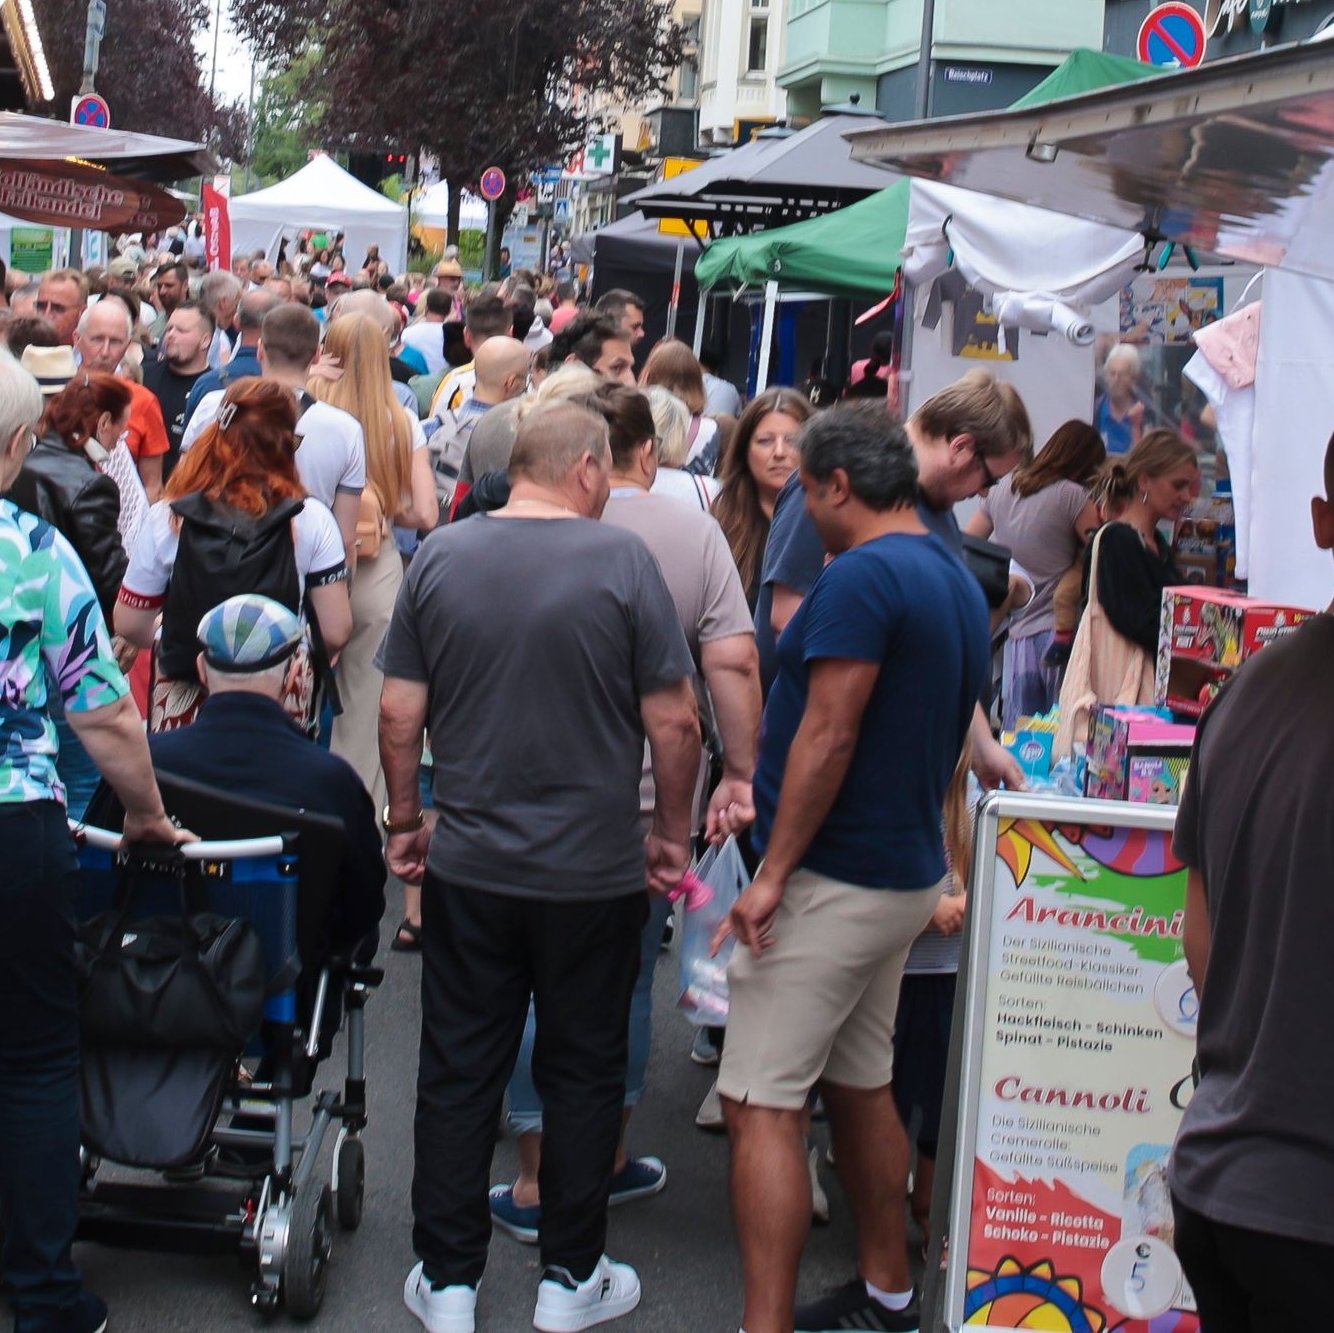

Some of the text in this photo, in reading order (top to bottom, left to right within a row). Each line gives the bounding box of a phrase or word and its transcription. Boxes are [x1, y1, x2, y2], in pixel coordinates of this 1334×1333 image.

[1005, 895, 1185, 939] Arancini
[1003, 934, 1112, 956] Der Sizilianische
[1000, 969, 1144, 995] Gefüllte Reisbällchen
[998, 993, 1046, 1011] Sorten:
[997, 1012, 1082, 1032] Hackfleisch
[1096, 1021, 1163, 1040] Schinken
[996, 1030, 1042, 1046] Spinat
[1057, 1035, 1113, 1052] Pistazie
[994, 1075, 1153, 1114] Cannoli
[991, 1115, 1101, 1137] Die Sizilianische
[989, 1150, 1043, 1167] Gefüllte
[987, 1187, 1036, 1206] Sorten:
[985, 1205, 1037, 1224] Vanille
[1050, 1211, 1104, 1230] Ricotta
[984, 1223, 1038, 1243] Schoko
[1052, 1230, 1110, 1249] Pistazie
[1130, 1260, 1149, 1294] 5
